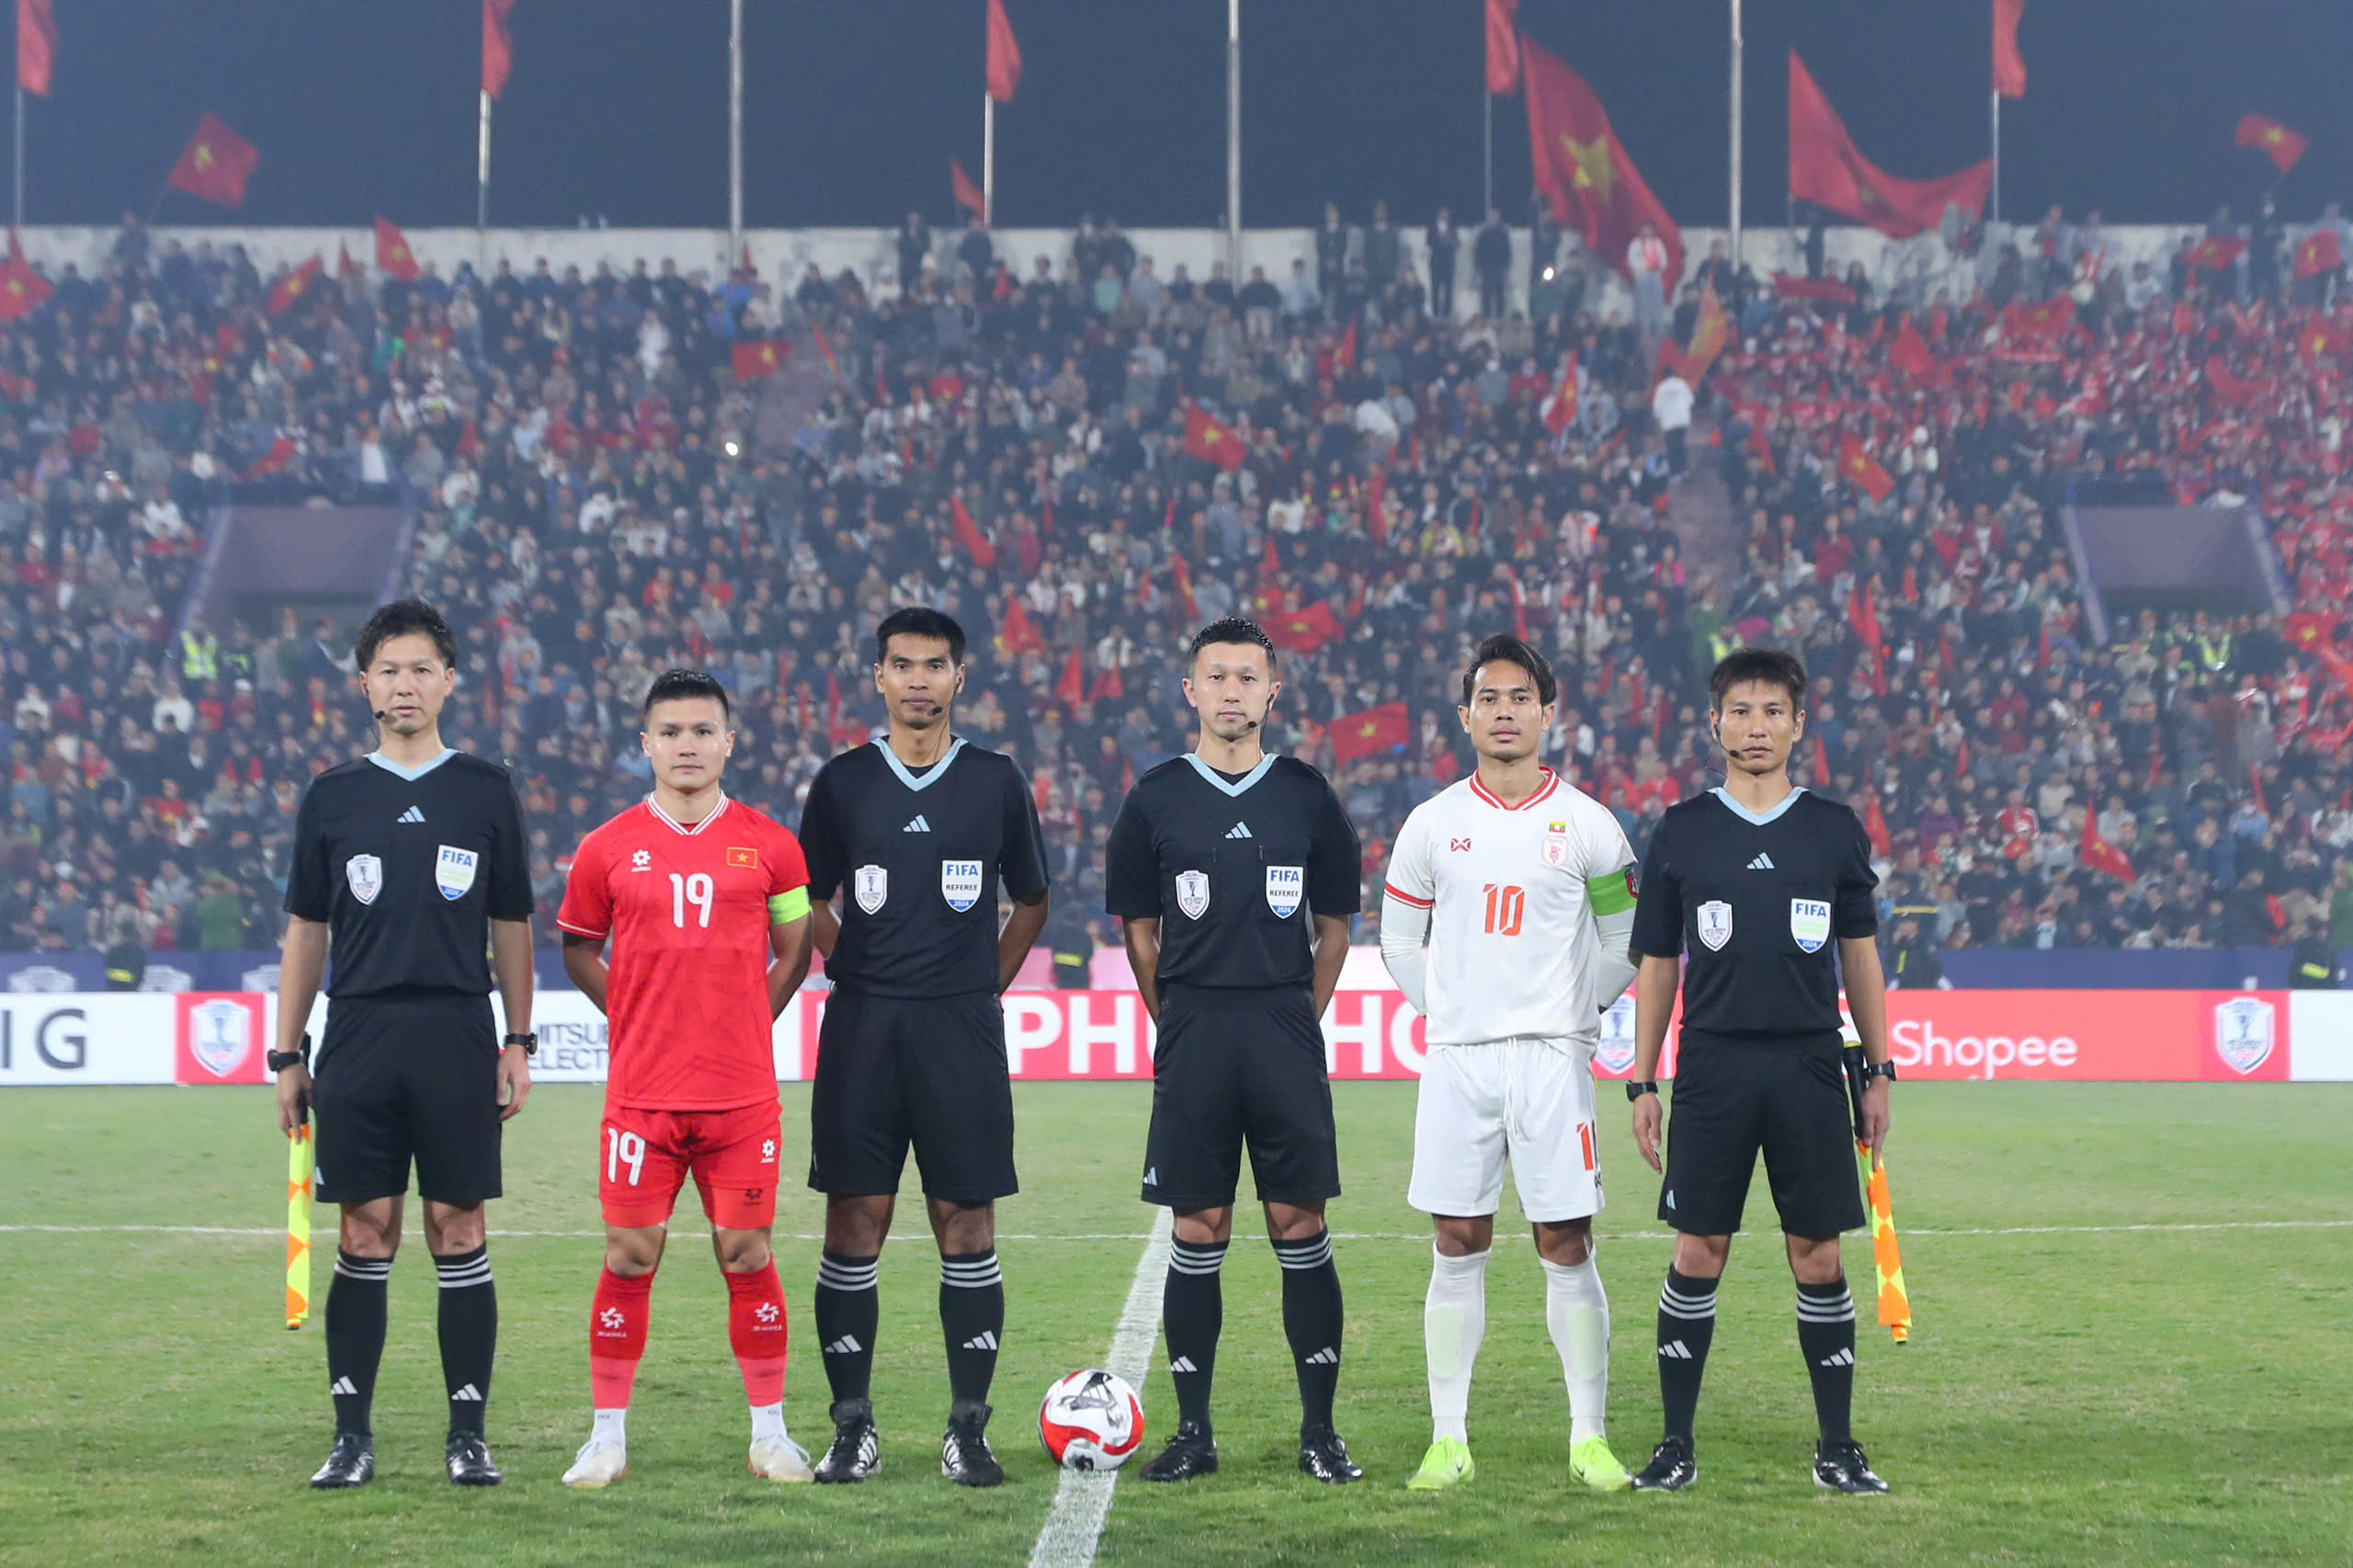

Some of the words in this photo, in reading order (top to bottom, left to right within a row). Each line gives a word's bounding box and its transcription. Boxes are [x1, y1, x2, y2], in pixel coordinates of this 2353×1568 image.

[442, 850, 472, 867] FIFA
[947, 865, 978, 876] FIFA
[1270, 869, 1300, 882] FIFA
[669, 873, 713, 928] 19
[1483, 883, 1525, 936] 10
[1795, 903, 1826, 916] FIFA
[1892, 1020, 2077, 1080] Shopee
[608, 1128, 646, 1187] 19
